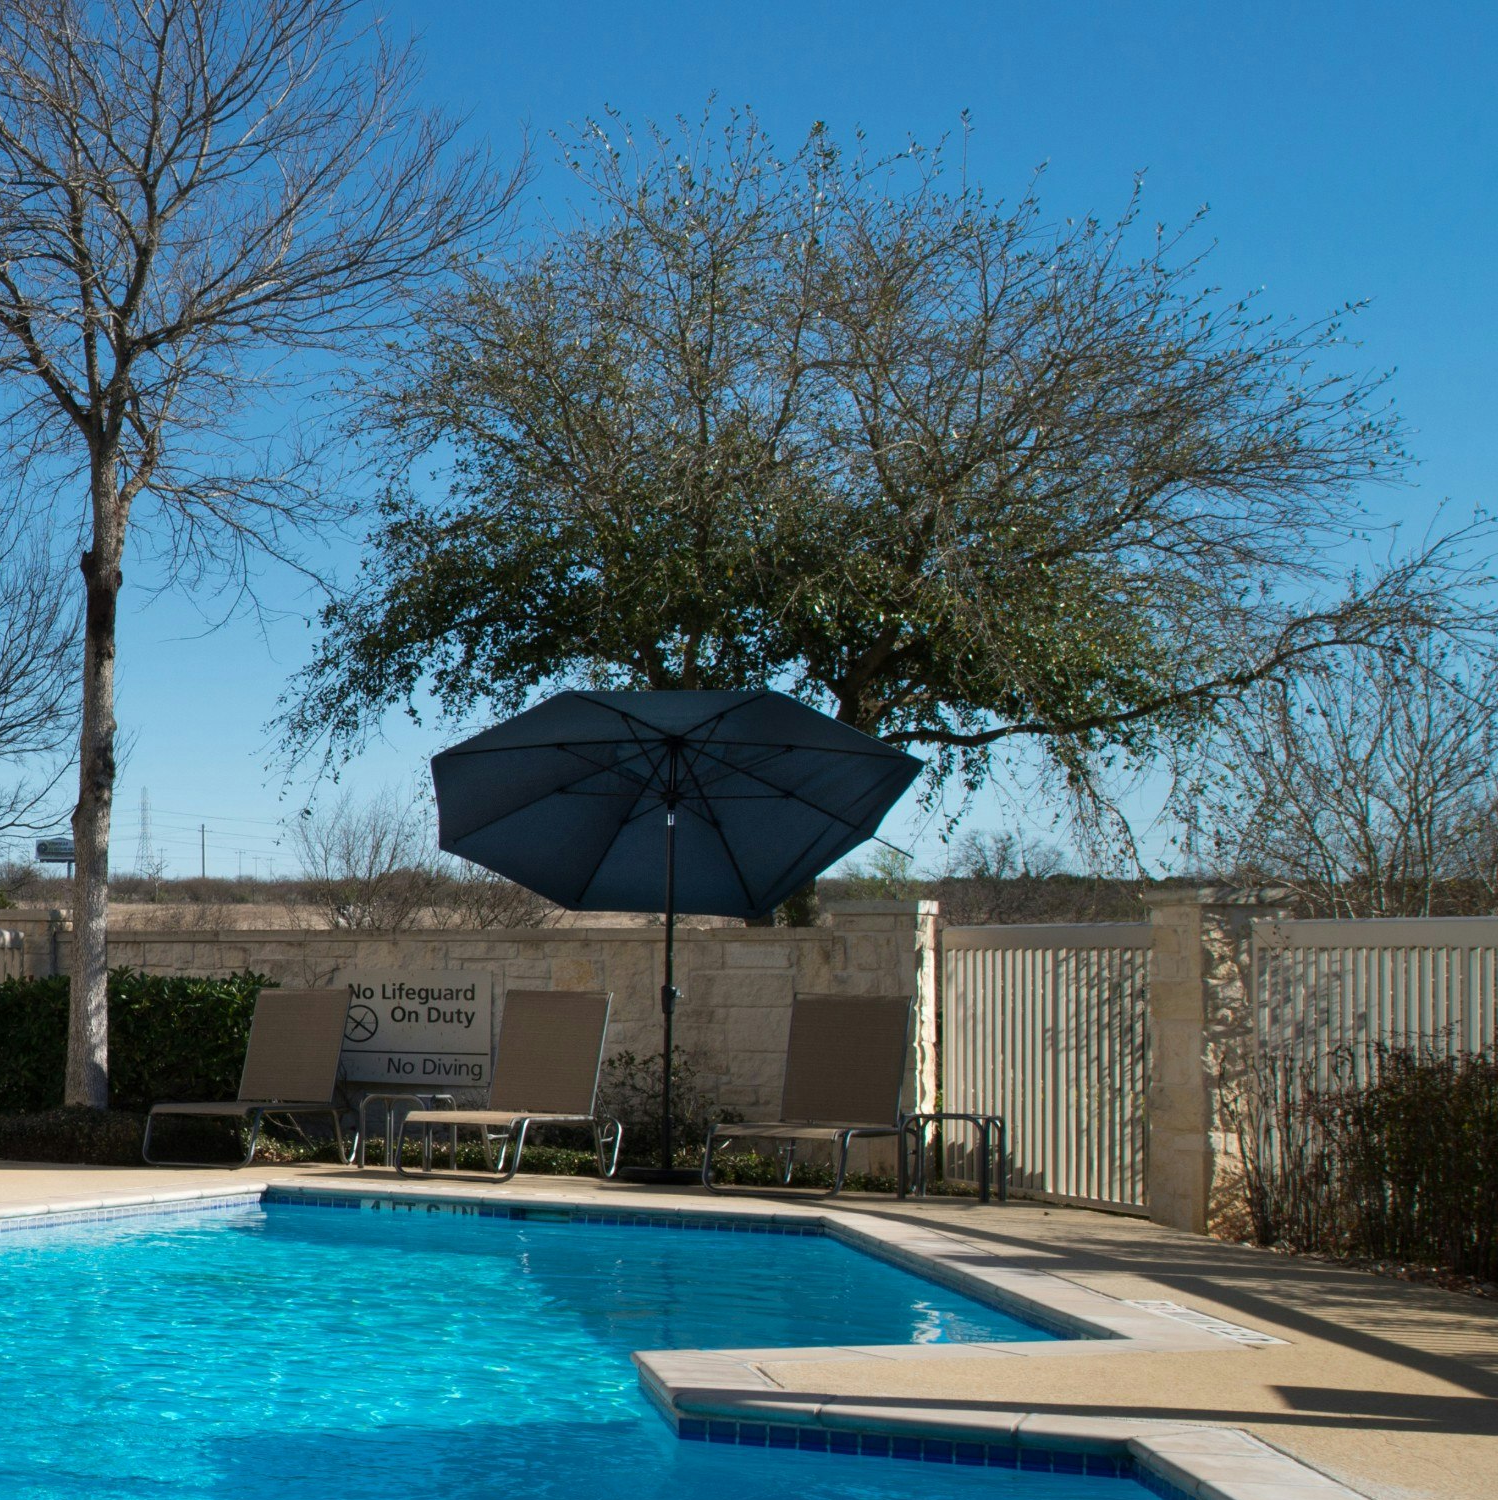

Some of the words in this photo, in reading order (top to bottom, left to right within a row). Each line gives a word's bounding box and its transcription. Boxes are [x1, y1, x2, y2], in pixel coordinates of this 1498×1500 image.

[348, 983, 375, 1001] No
[381, 983, 476, 1004] Lifeguard
[390, 1006, 419, 1023] On
[427, 1006, 476, 1028] Duty
[387, 1057, 415, 1075] No
[422, 1058, 483, 1081] Diving
